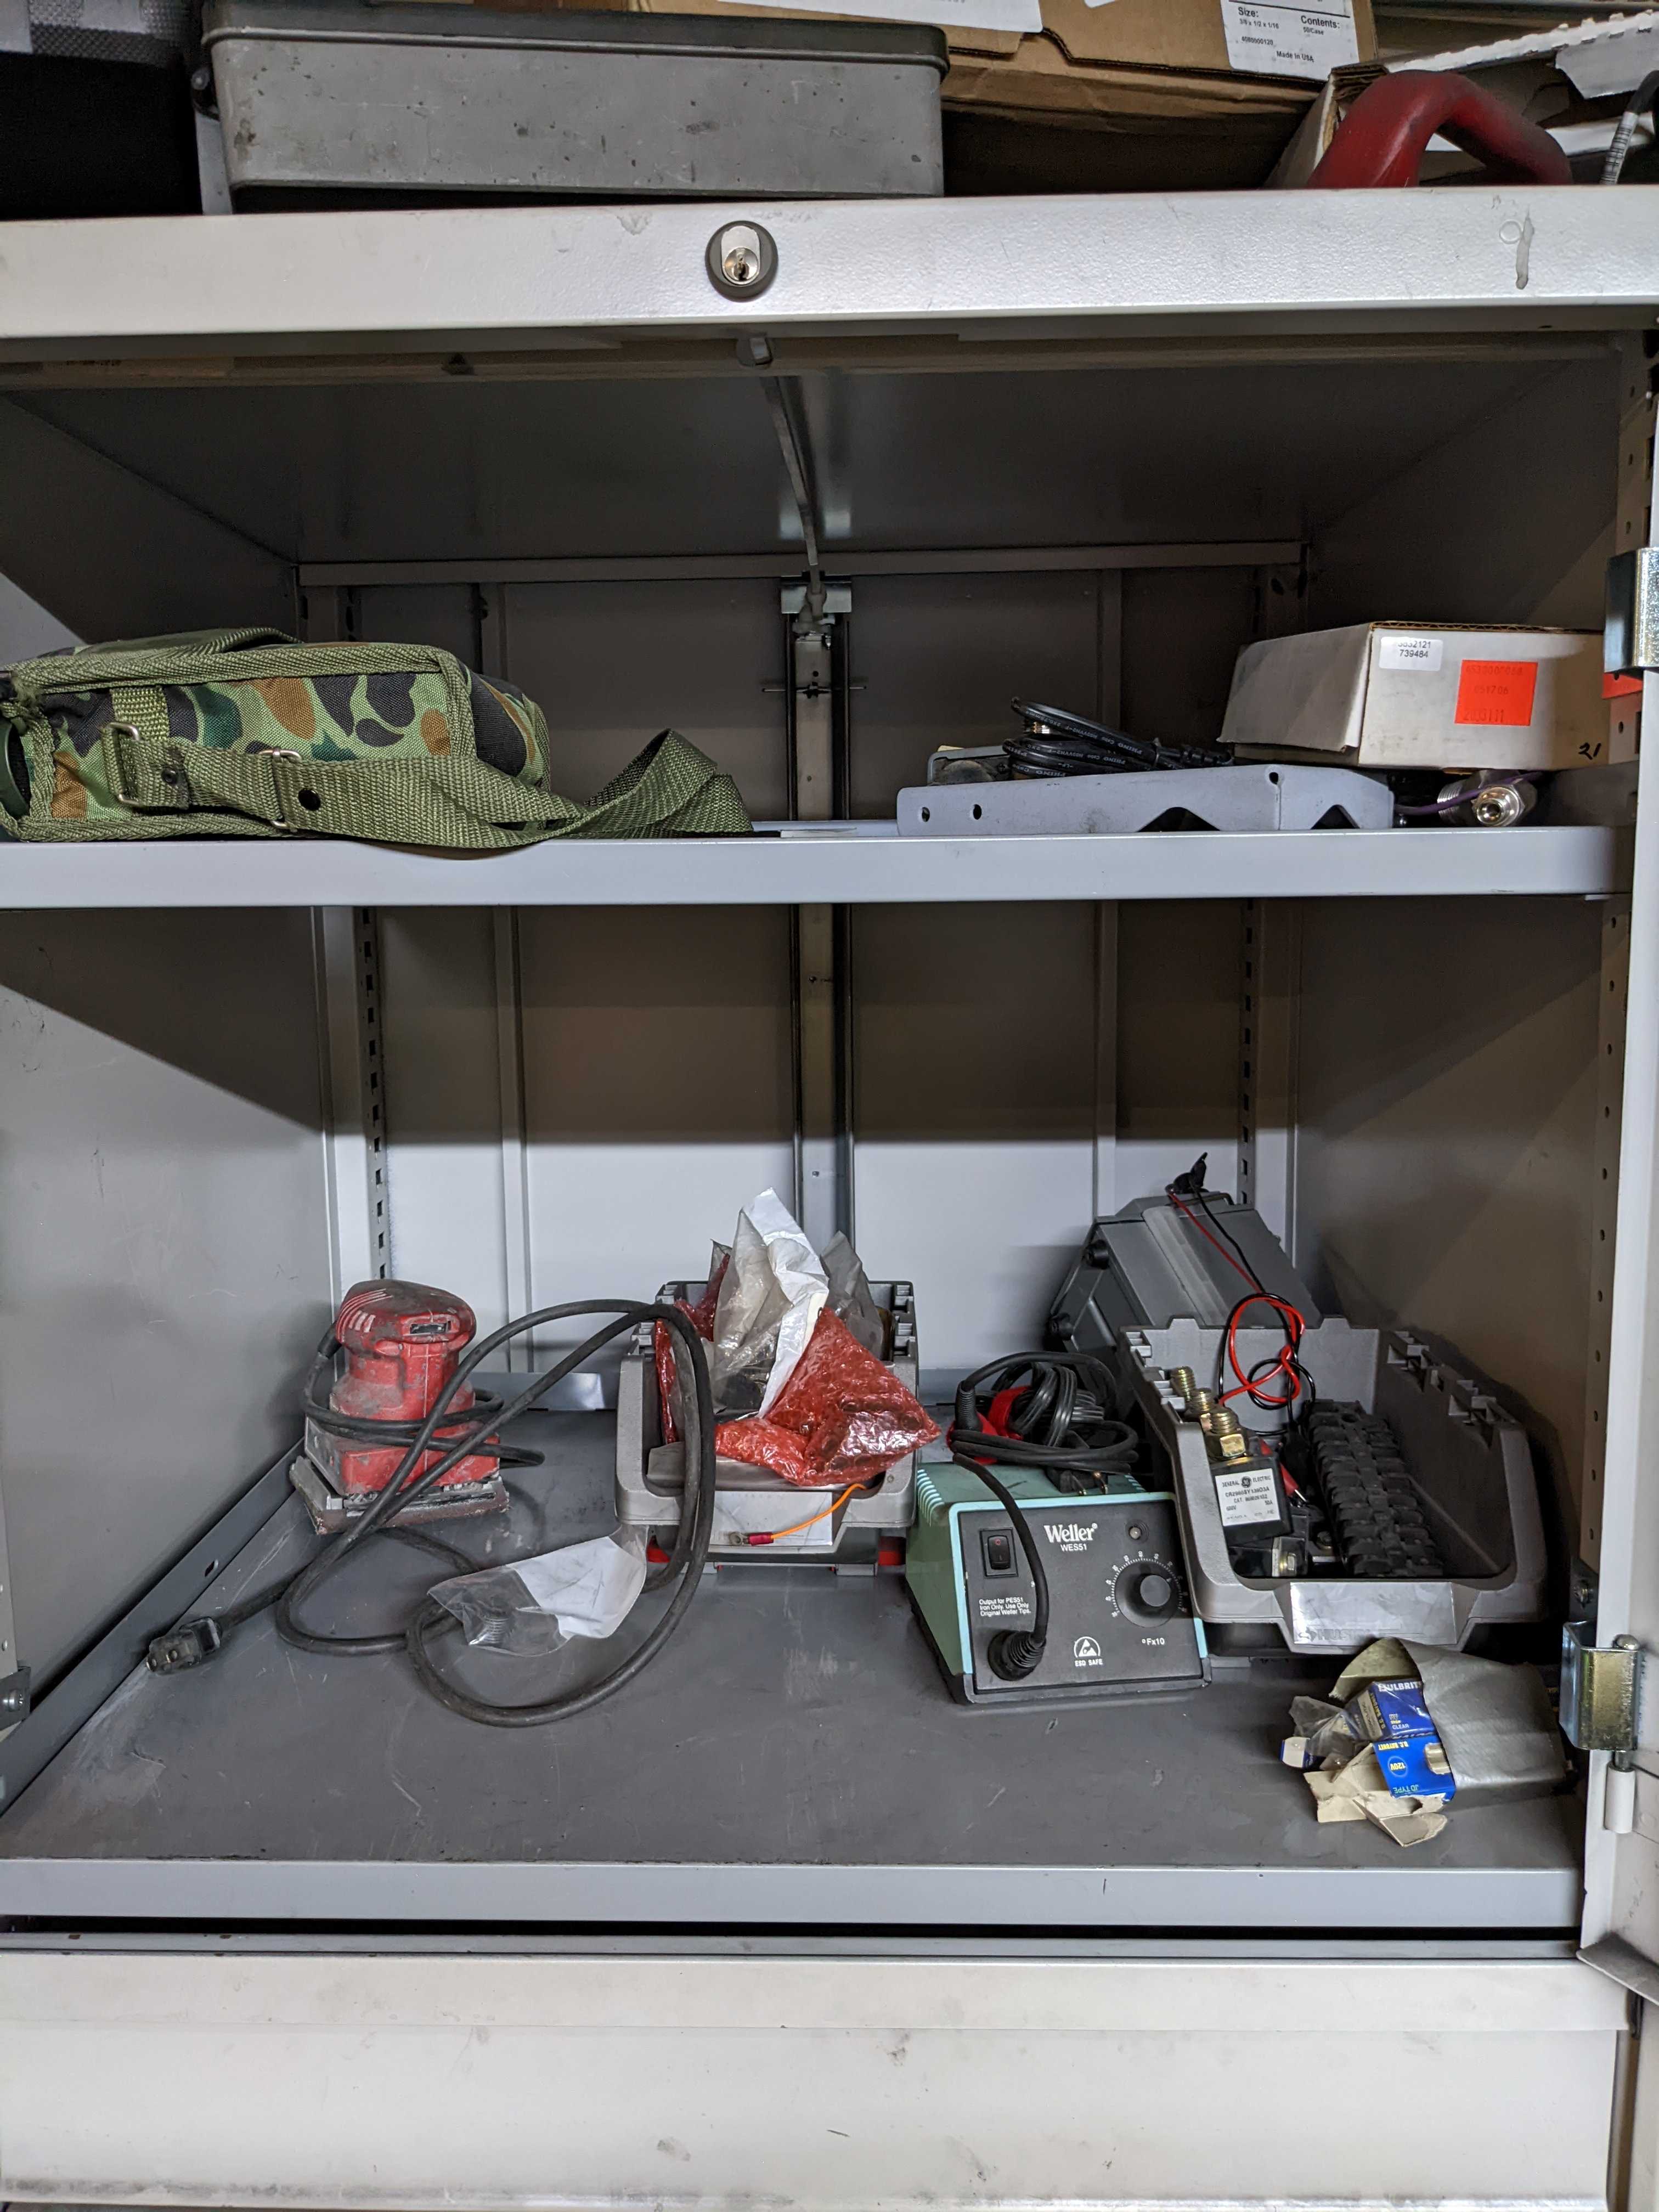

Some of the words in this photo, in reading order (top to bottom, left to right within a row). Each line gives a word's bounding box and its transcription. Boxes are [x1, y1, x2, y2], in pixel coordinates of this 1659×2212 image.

[1238, 7, 1259, 17] Size:
[1301, 15, 1340, 29] Contents:
[1302, 53, 1314, 61] USA
[1400, 650, 1429, 658] 739484
[1043, 1523, 1095, 1543] Weller
[1060, 1543, 1087, 1552] WES51
[1390, 1762, 1406, 1771] 120V
